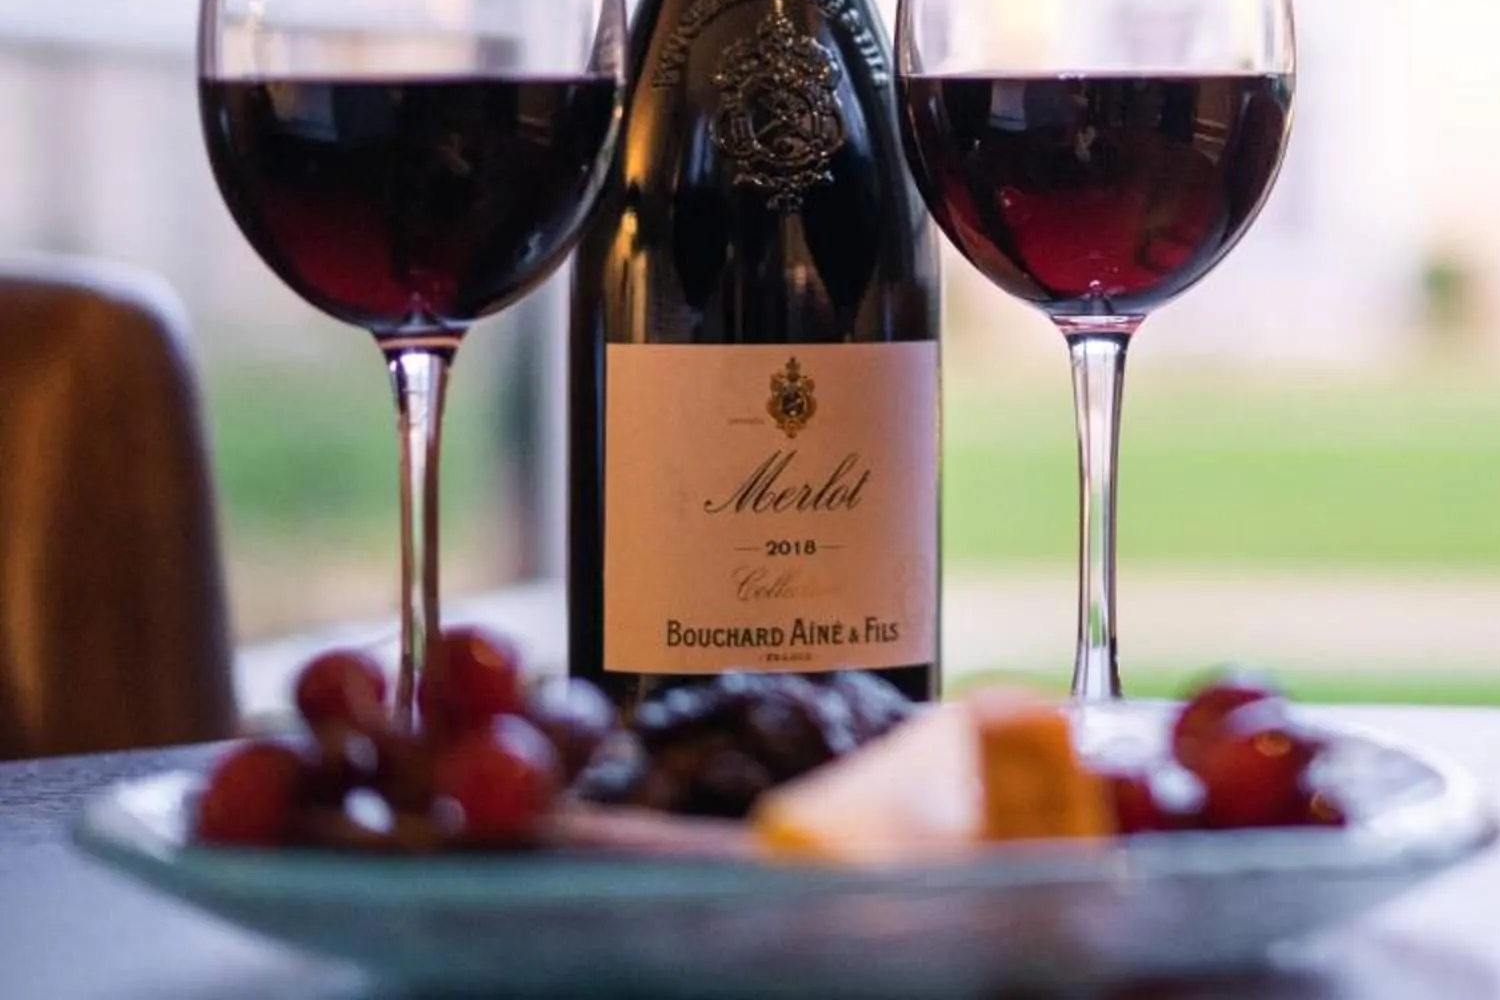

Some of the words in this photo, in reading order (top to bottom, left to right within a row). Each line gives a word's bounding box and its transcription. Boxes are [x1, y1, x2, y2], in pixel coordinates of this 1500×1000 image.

[703, 450, 871, 514] Merlot
[766, 540, 817, 556] 2018
[666, 619, 784, 648] BOUCHARD
[848, 626, 859, 644] &
[865, 616, 899, 643] FILS
